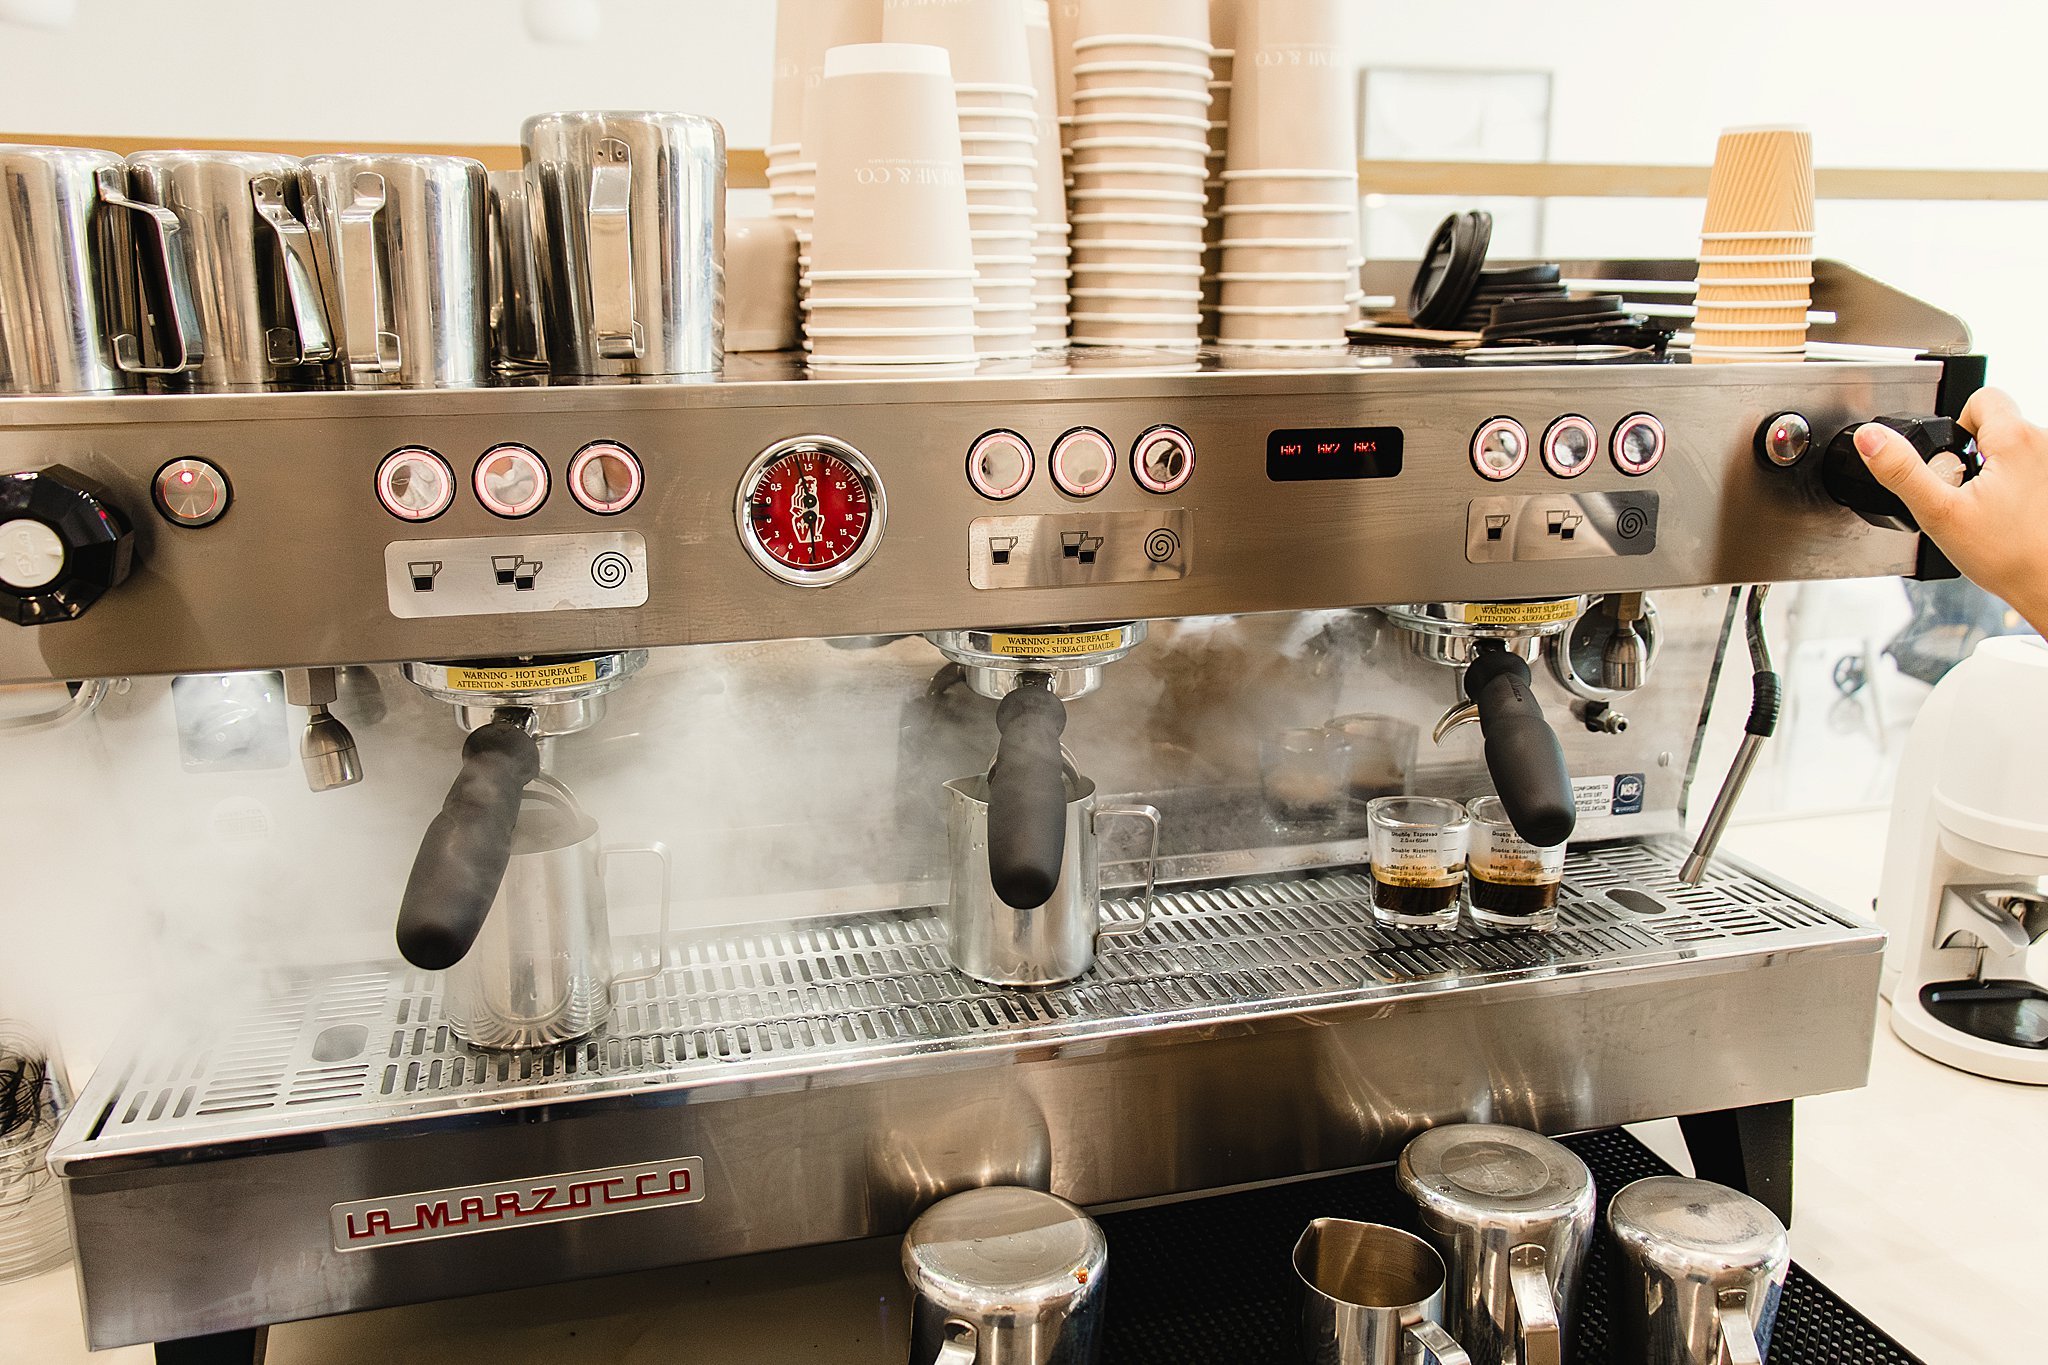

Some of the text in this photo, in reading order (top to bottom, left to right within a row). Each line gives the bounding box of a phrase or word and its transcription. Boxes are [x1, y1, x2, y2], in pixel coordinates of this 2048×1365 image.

[895, 167, 912, 185] &
[825, 468, 831, 476] 2
[770, 483, 782, 492] 0,5
[835, 481, 847, 490] 2,5
[765, 496, 772, 504] 0
[847, 494, 853, 502] 3
[774, 530, 780, 538] 3
[788, 542, 793, 550] 6
[825, 541, 834, 549] 12
[807, 546, 813, 554] 9
[1481, 607, 1521, 615] WARNING
[1526, 606, 1542, 614] HOT
[1473, 615, 1517, 623] ATTENTION
[1008, 637, 1050, 645] WARNING
[1057, 636, 1075, 644] HOT
[1076, 633, 1110, 644] SURFACE
[1000, 646, 1046, 654] ATTENTION
[1052, 643, 1086, 654] SURFACE
[1087, 641, 1115, 652] CHAUDE
[462, 671, 508, 680] WARNING
[515, 670, 536, 679] HOT
[538, 665, 580, 678] SURFACE
[457, 679, 504, 689] ATTENTION
[511, 678, 551, 688] SURFACE
[552, 673, 588, 685] CHAUDE
[1620, 782, 1639, 797] NSF
[346, 1208, 391, 1240] LA
